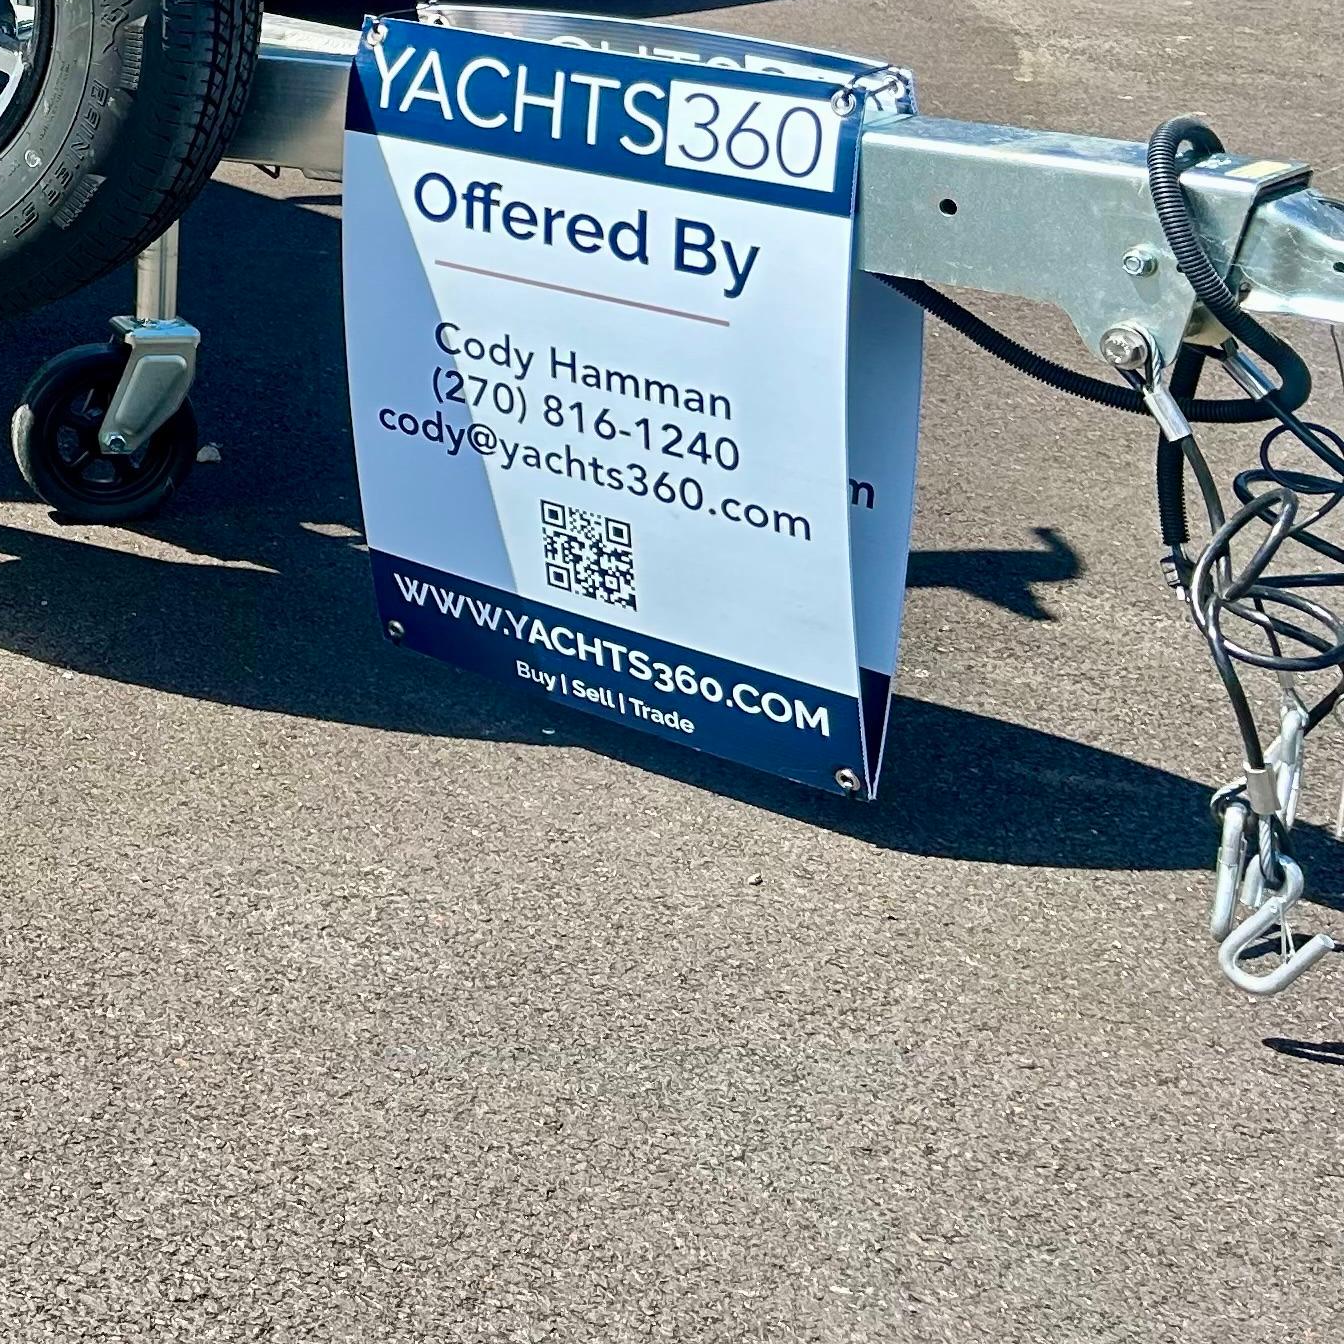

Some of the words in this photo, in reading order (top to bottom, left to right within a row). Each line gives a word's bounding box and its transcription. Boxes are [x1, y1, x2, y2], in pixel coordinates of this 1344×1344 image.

[413, 172, 649, 266] Offered
[674, 217, 760, 299] By
[431, 366, 527, 424] (270)
[542, 394, 739, 472] 816-1240
[434, 322, 534, 380] Cody
[550, 346, 733, 421] Hamman
[378, 406, 812, 541] cody@yachts360.com
[393, 572, 830, 737] WWW.YACHTS360.COM
[515, 659, 556, 693] Buy
[571, 679, 615, 709] Sell
[629, 697, 695, 734] Trade
